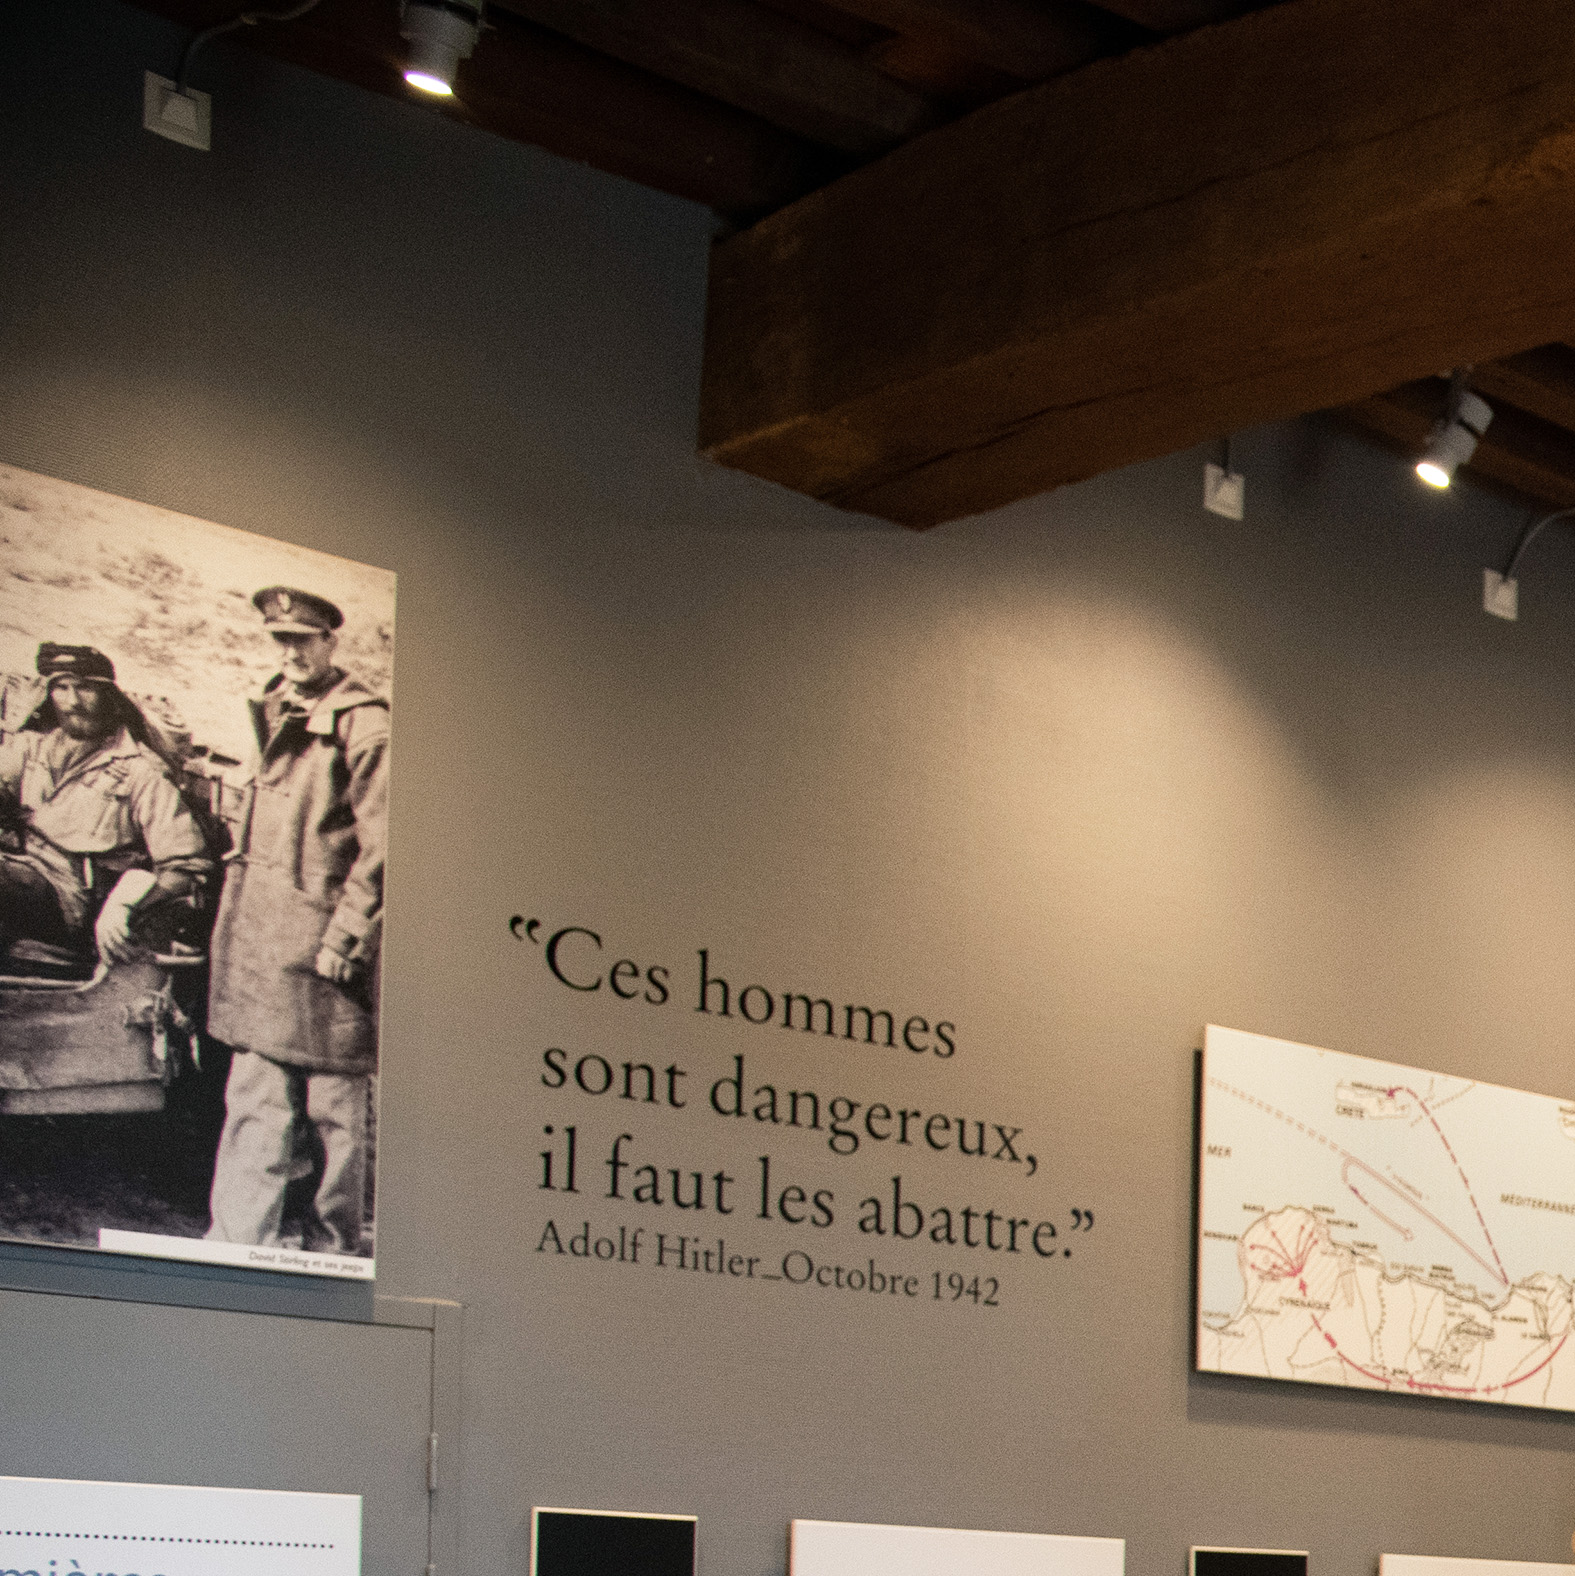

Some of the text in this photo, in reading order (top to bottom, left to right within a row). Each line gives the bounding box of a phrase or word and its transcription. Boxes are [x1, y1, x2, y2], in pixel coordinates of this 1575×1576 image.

[508, 914, 958, 1059] “Ces hommes
[540, 1045, 1041, 1176] sont dangereux,
[537, 1125, 1094, 1259] il faut les abattre.”
[535, 1219, 643, 1264] Adolf
[931, 1272, 1000, 1308] 1942
